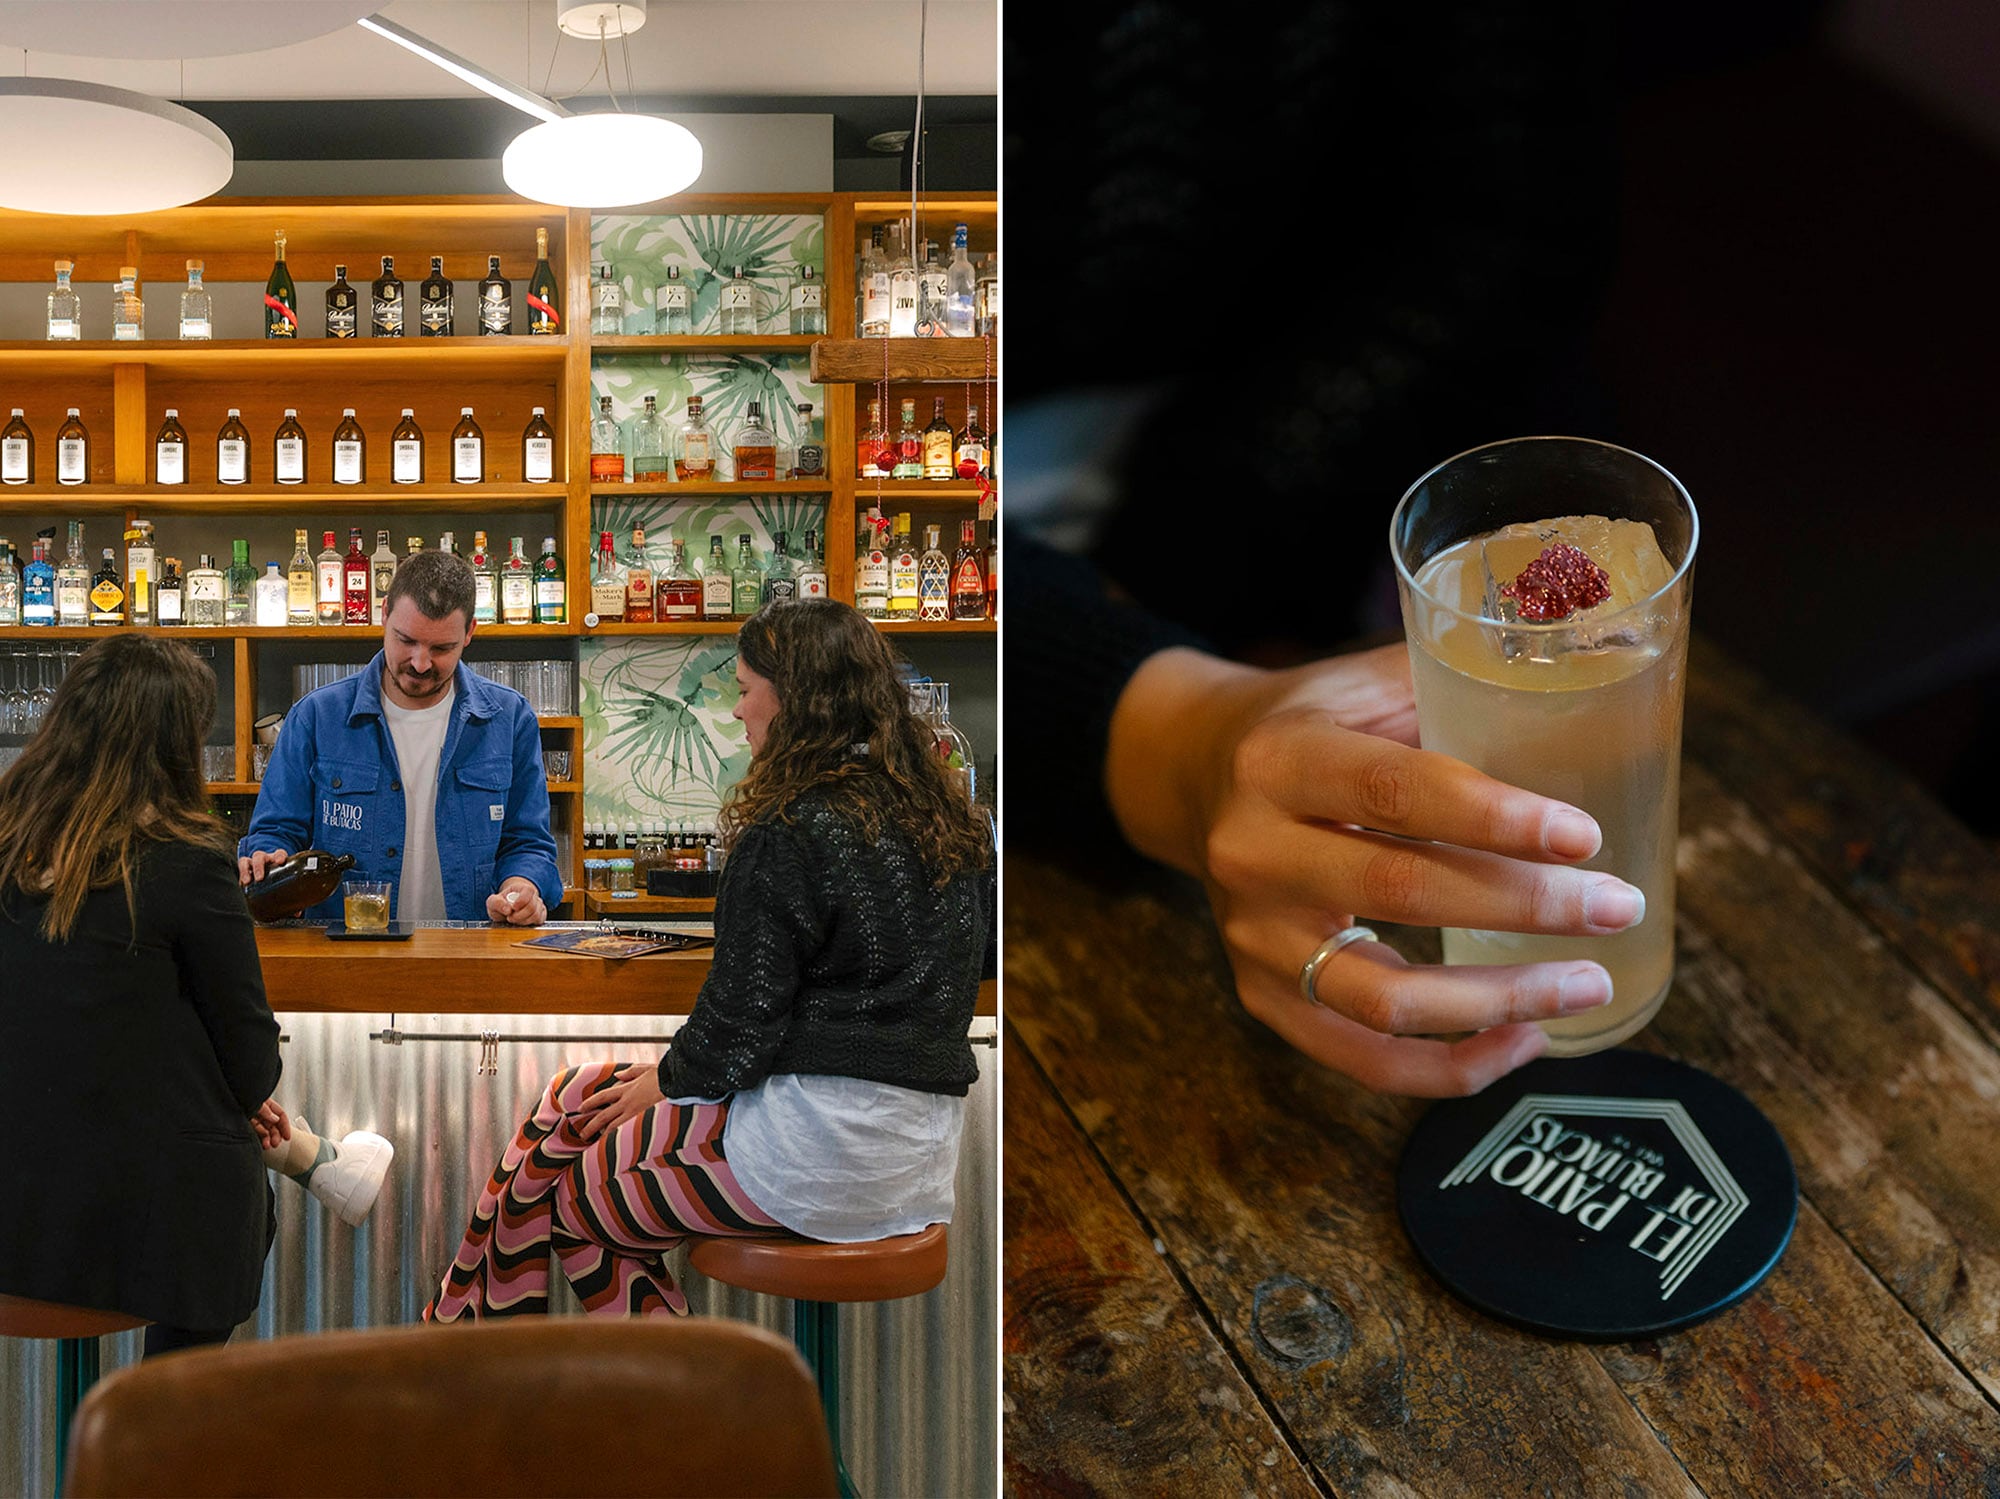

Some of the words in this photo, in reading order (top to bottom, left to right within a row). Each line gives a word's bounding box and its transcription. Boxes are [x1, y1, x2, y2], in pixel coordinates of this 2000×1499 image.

[352, 577, 362, 585] 24
[330, 815, 362, 831] BUTACAS
[333, 802, 363, 821] PATIO
[1520, 1116, 1667, 1200] BUTACAS
[1489, 1142, 1632, 1232] PATIO
[1628, 1204, 1694, 1263] EL
